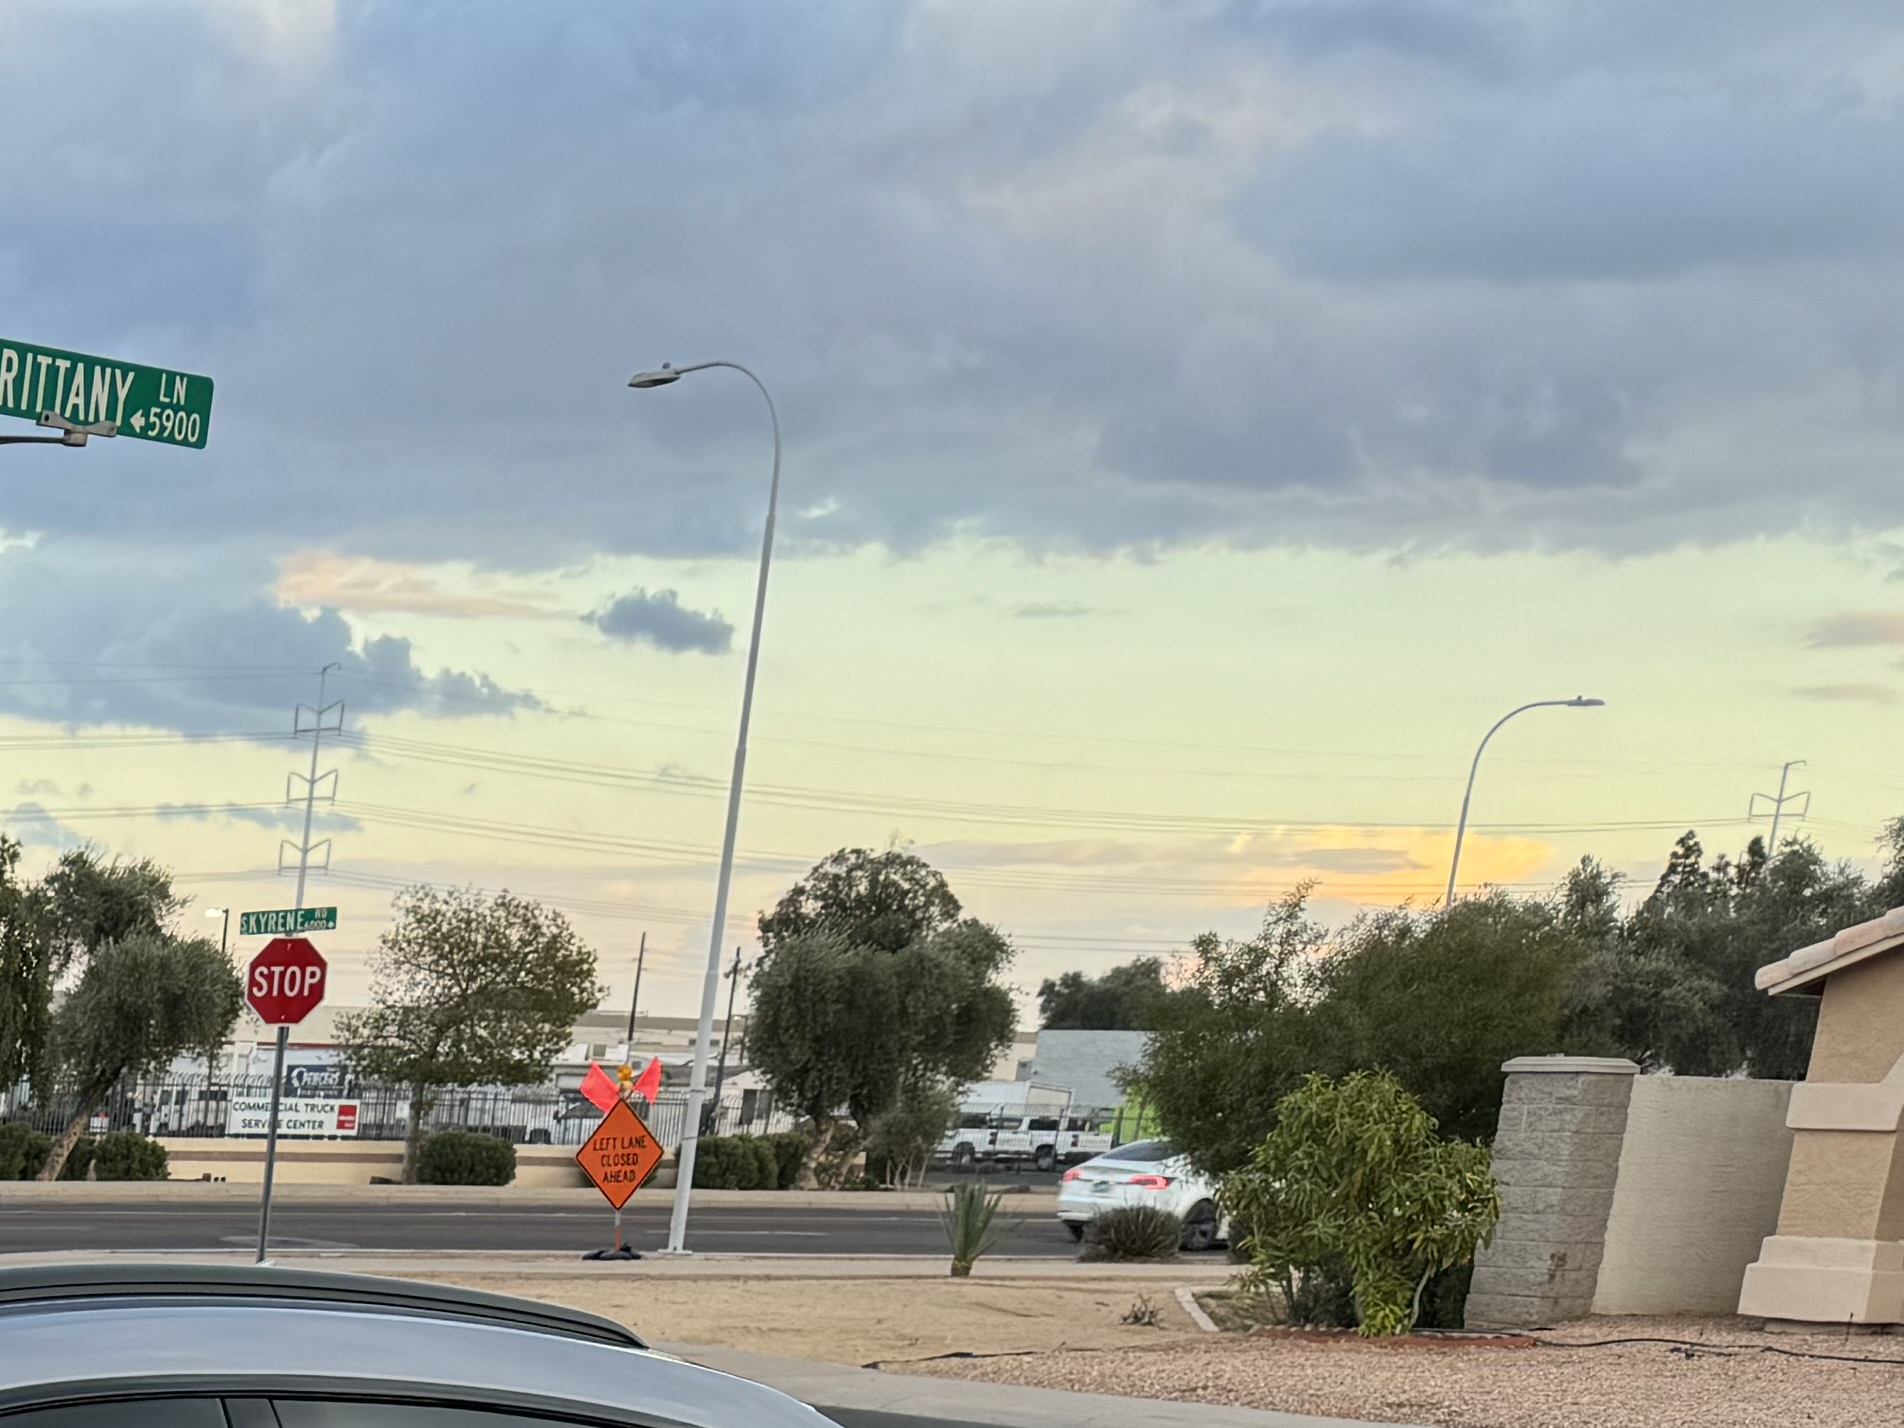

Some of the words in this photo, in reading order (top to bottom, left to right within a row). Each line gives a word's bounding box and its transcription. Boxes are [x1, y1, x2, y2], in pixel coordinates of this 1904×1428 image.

[159, 373, 188, 406] LN
[148, 408, 201, 443] 5900
[241, 916, 248, 932] S
[248, 910, 305, 933] KYRENE
[252, 965, 322, 998] STOP
[232, 1101, 300, 1113] COMMECIAL
[304, 1103, 336, 1114] TRUCK
[241, 1118, 283, 1130] SERVE
[286, 1119, 325, 1130] CENTER
[593, 1137, 618, 1152] LEFT
[621, 1135, 647, 1150] LANE
[600, 1152, 639, 1168] CLOSED
[602, 1169, 636, 1184] AHEAD
